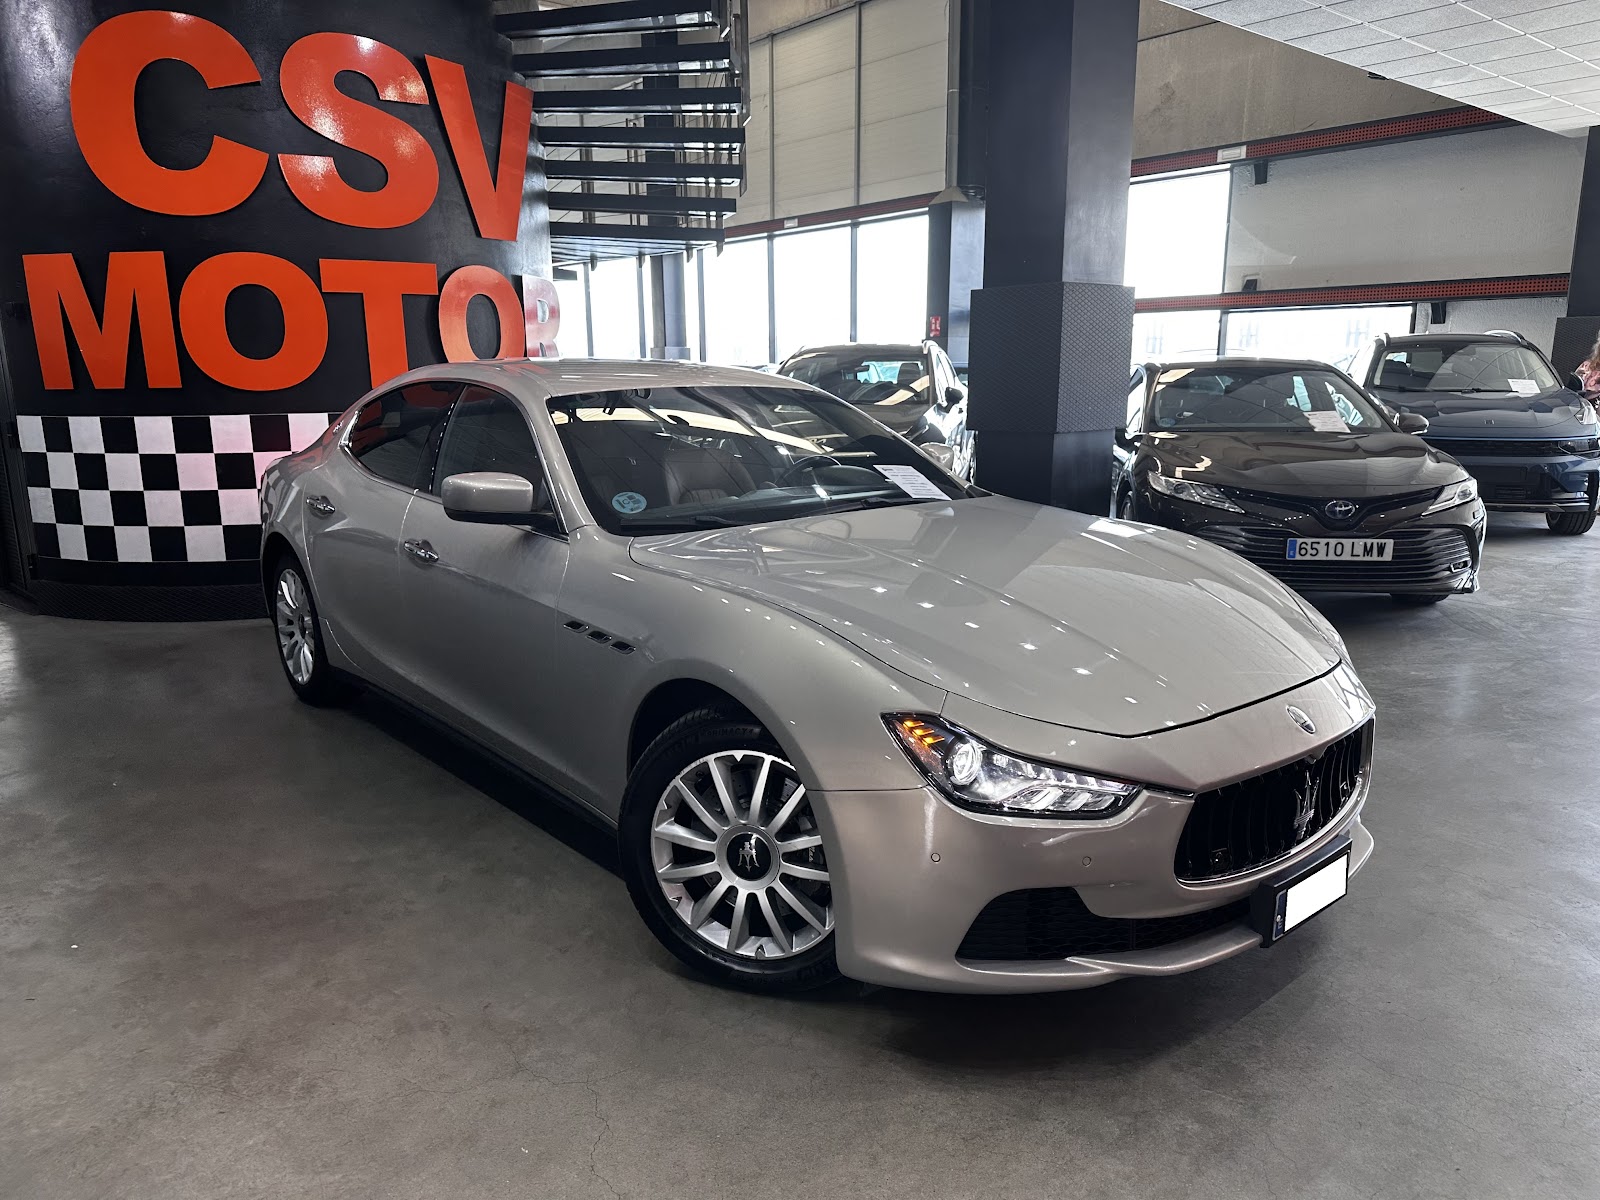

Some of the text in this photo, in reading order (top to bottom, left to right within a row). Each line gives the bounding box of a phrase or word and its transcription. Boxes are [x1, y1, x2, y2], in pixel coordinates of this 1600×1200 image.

[70, 9, 535, 242] CSV
[22, 250, 561, 391] MOTOR
[1298, 541, 1387, 558] 6510 LMW
